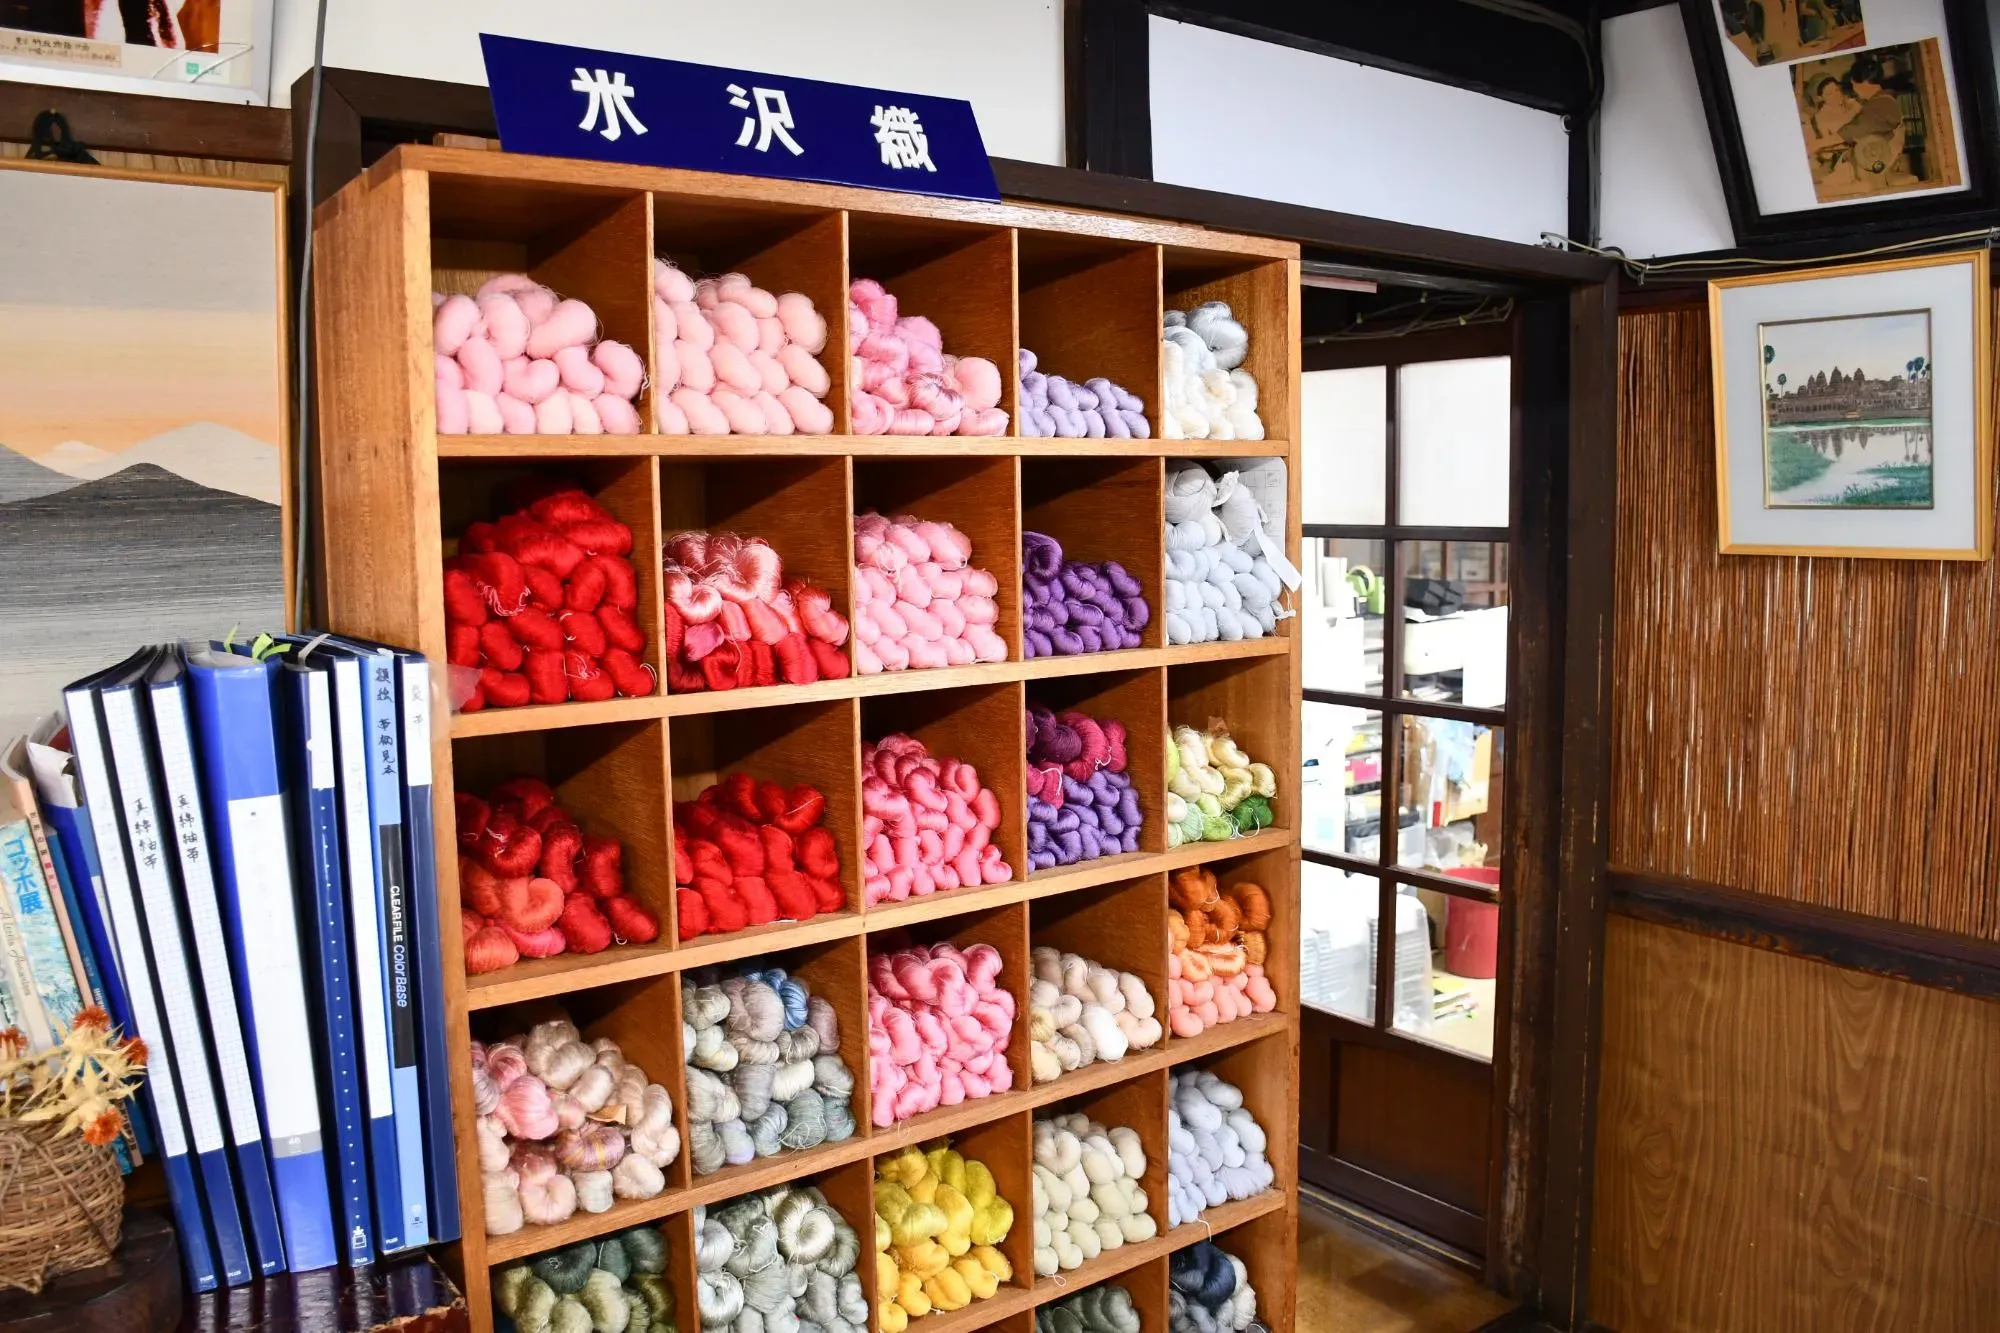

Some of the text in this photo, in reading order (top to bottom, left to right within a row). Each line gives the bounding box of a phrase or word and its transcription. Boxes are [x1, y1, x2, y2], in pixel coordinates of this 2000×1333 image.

[571, 68, 937, 172] 米沢織
[4, 834, 44, 915] ゴッホ展
